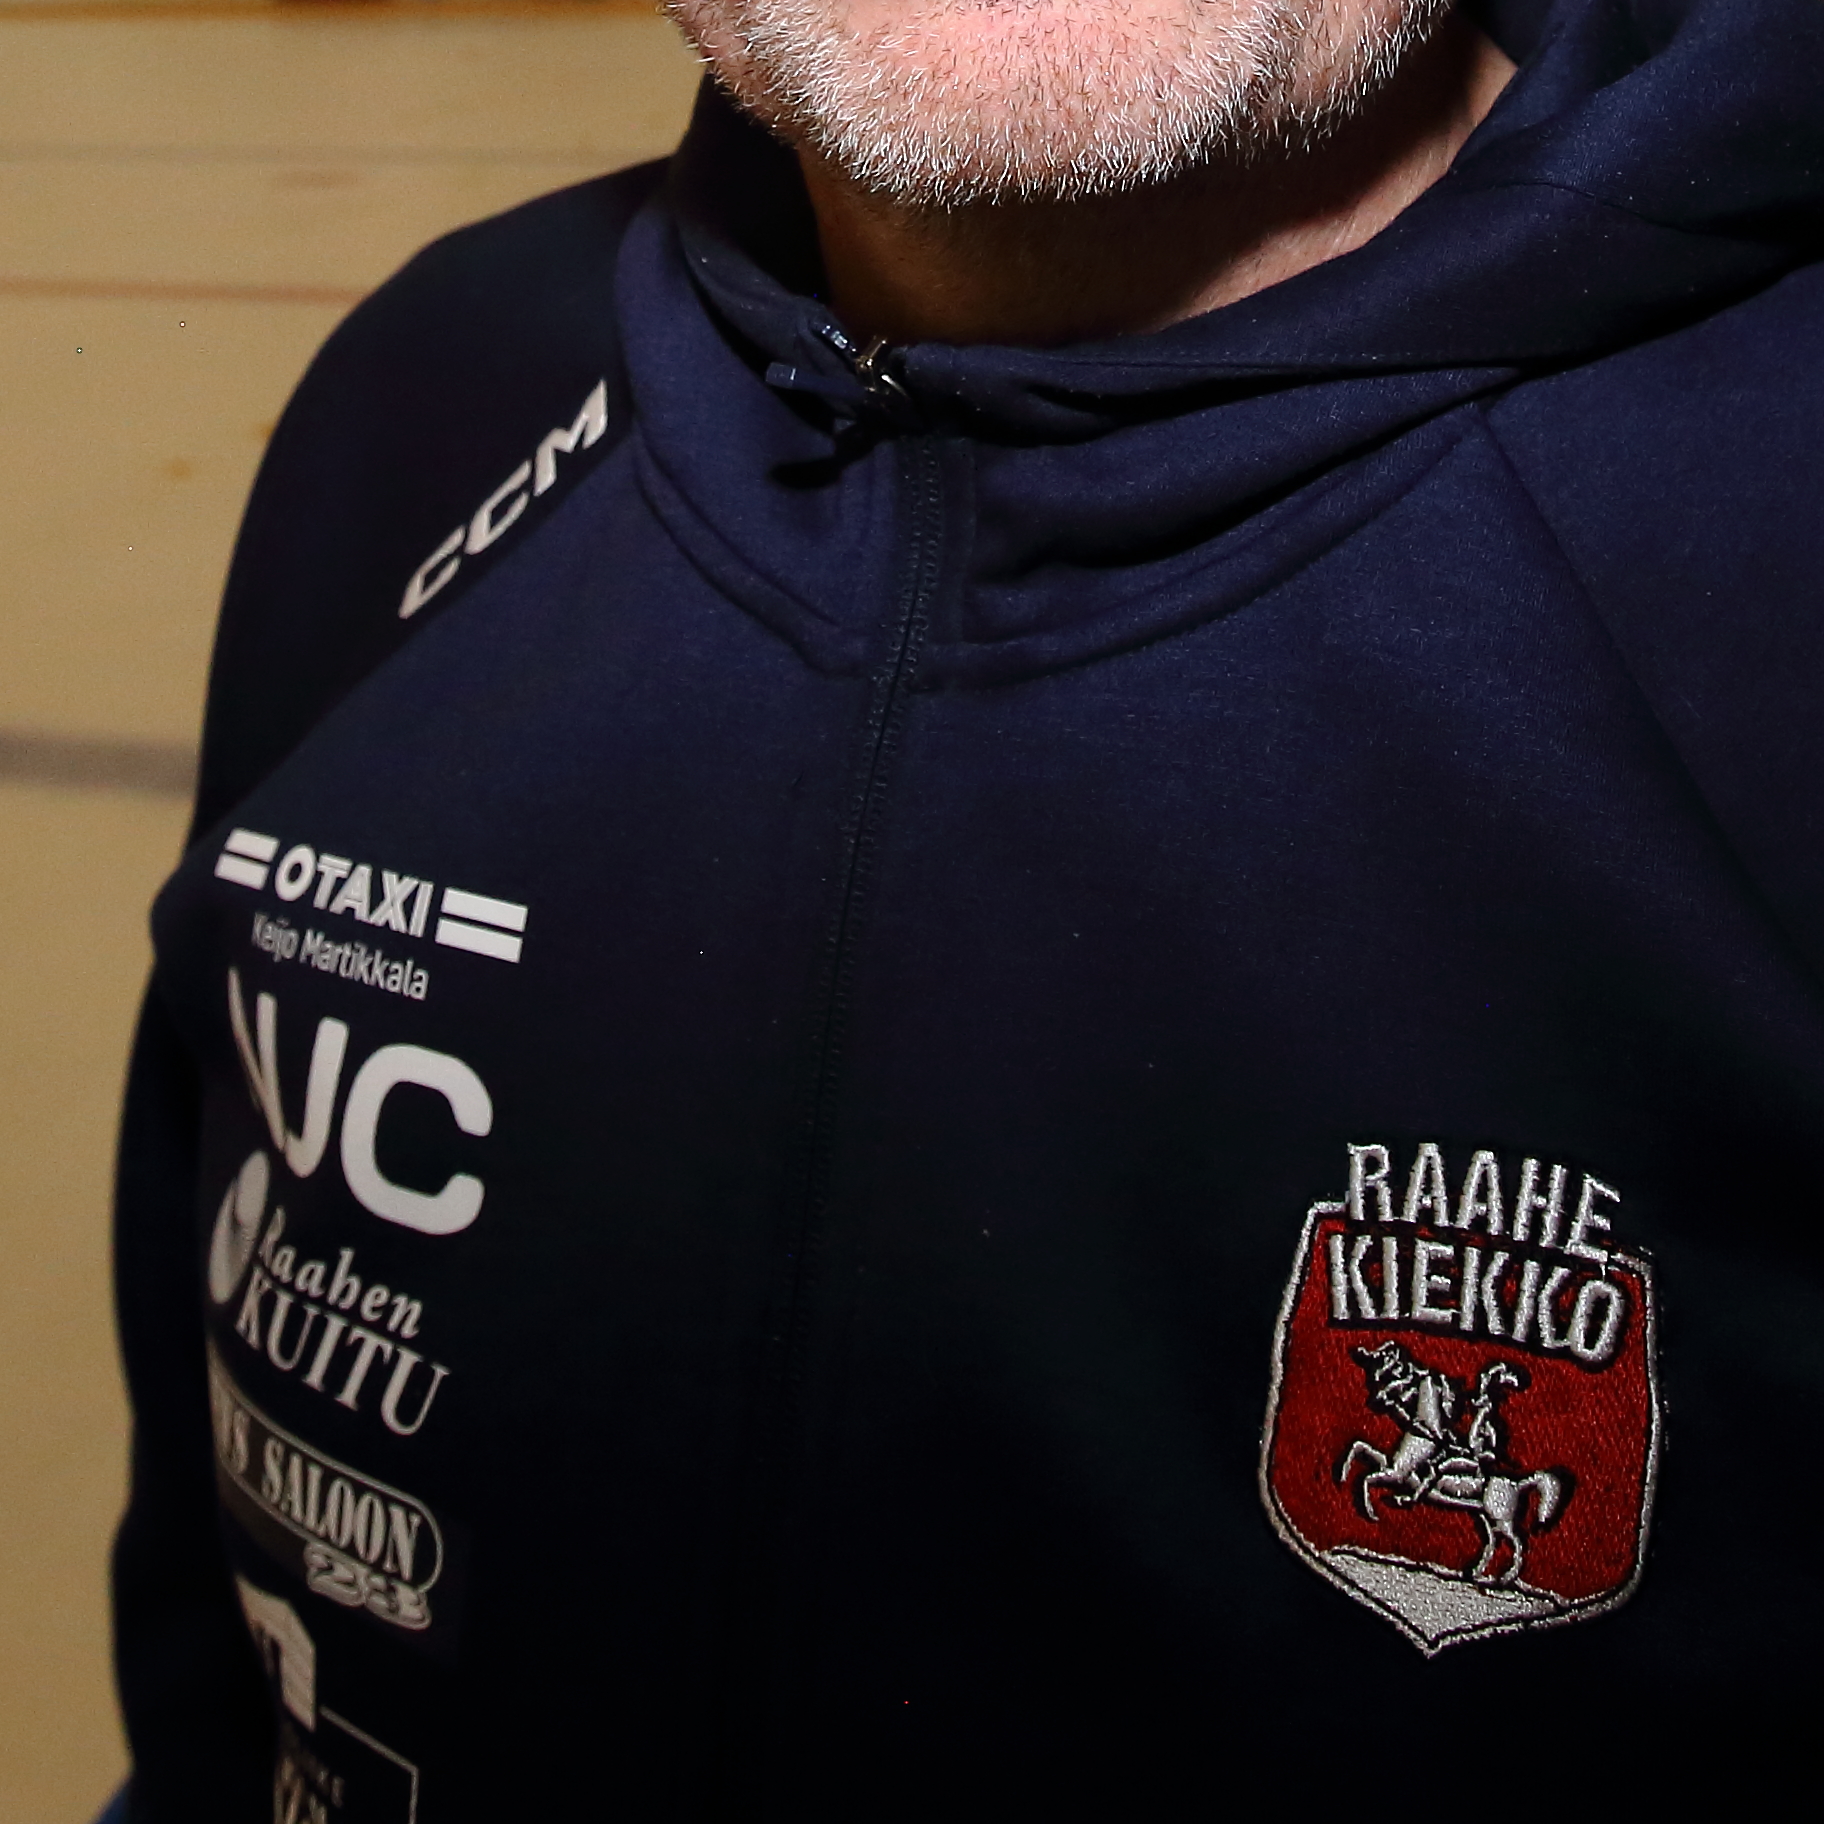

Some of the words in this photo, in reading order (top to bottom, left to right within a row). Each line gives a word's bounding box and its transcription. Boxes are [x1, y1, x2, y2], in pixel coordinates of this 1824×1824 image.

[397, 378, 609, 620] CCM
[250, 910, 301, 963] Keijo
[274, 843, 435, 938] OTAXI
[298, 926, 431, 1002] Martikkala
[1346, 1141, 1622, 1262] RAAHE
[234, 1263, 453, 1438] KUITU
[1327, 1233, 1627, 1363] KIEKKO
[259, 1435, 424, 1582] SALOON
